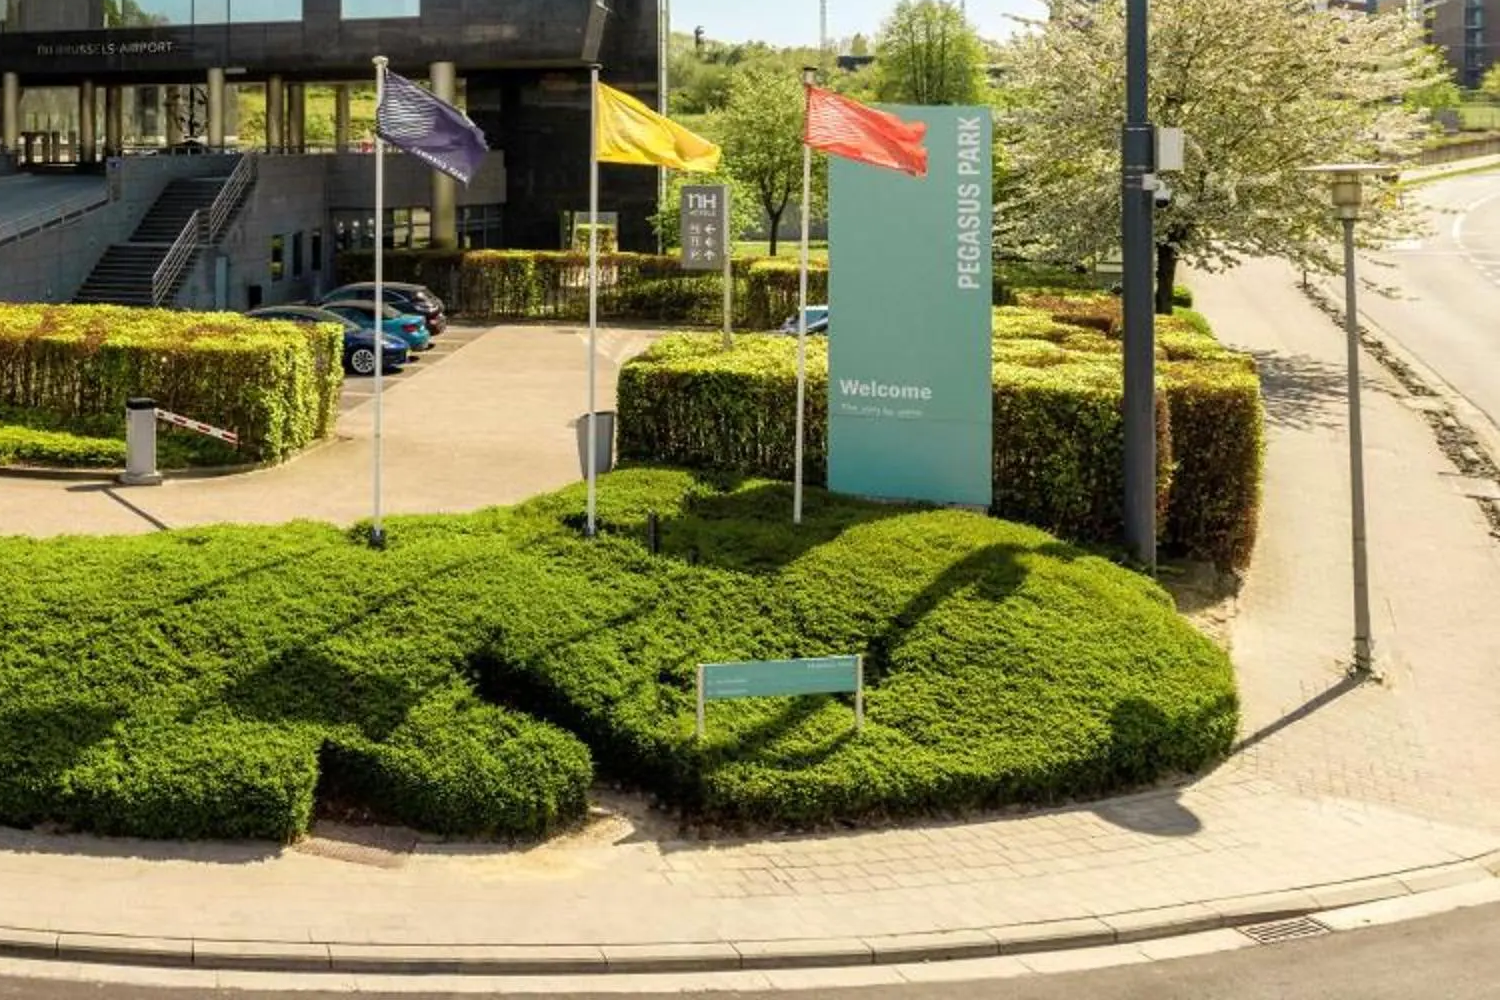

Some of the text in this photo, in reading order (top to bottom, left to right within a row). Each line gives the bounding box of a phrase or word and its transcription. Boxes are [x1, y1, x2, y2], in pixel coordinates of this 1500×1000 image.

[957, 116, 981, 289] PEGASUS PARK
[839, 379, 933, 400] Welcome
